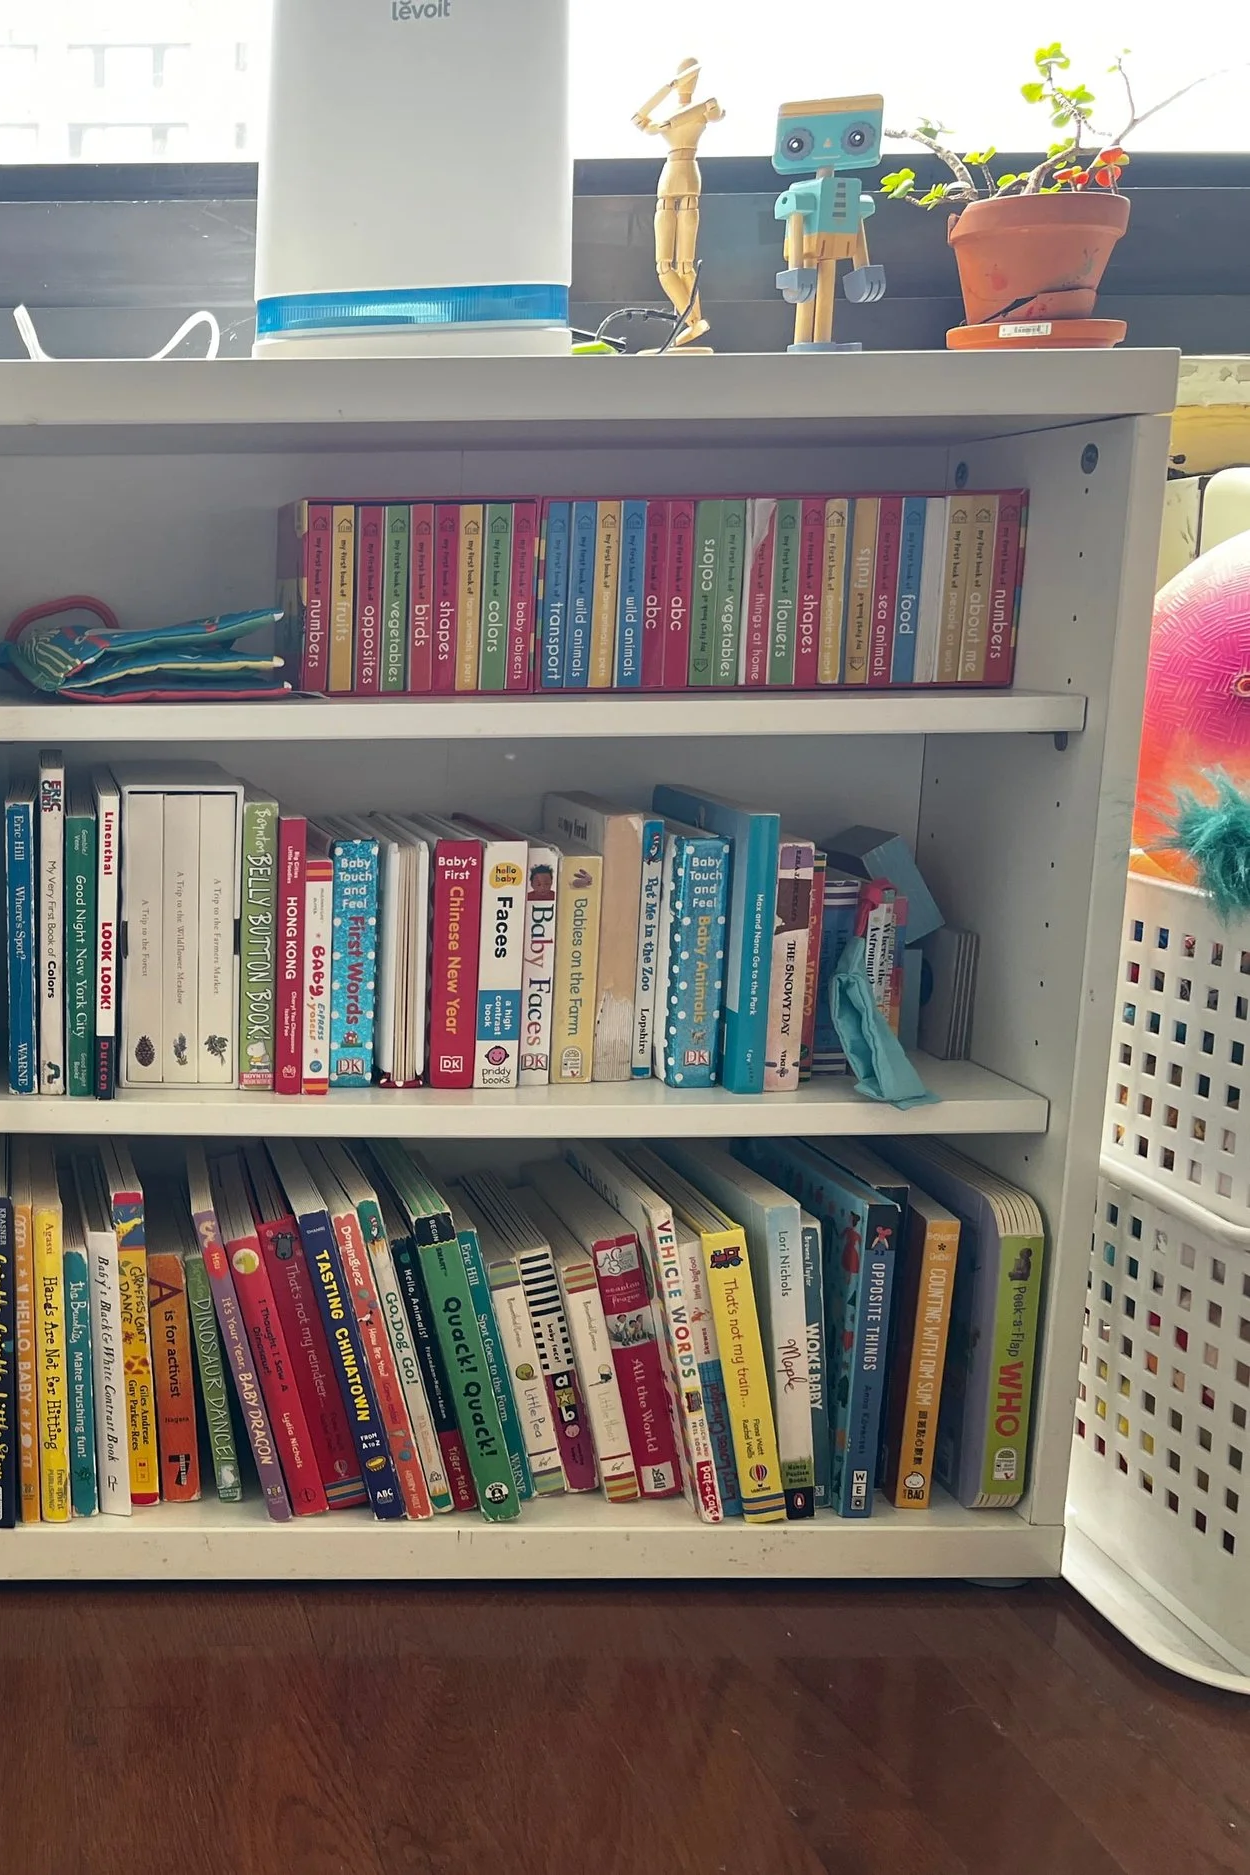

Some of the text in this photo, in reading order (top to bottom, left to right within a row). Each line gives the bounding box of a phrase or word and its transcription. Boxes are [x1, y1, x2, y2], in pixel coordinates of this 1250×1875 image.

[698, 538, 715, 591] colors
[309, 599, 325, 668] numbers
[388, 601, 402, 682] vegetables
[414, 604, 430, 647] birds
[436, 601, 455, 661] shapes
[486, 600, 503, 653] colors
[546, 601, 564, 681] transport
[645, 594, 661, 630] abc
[670, 596, 686, 631] abc
[719, 595, 734, 677] vegetables
[774, 598, 793, 658] flowers
[800, 594, 819, 654] shapes
[899, 593, 915, 635] food
[989, 589, 1007, 659] numbers
[362, 605, 376, 684] opposites
[13, 815, 25, 860] Eric Hill
[104, 811, 114, 875] Linenthal
[341, 857, 371, 871] Baby
[438, 856, 477, 869] Baby's
[692, 856, 722, 869] Baby
[175, 880, 184, 897] Trip
[176, 899, 183, 908] to
[338, 871, 372, 882] Touch
[343, 885, 367, 896] and
[444, 870, 470, 880] First
[689, 870, 723, 881] Touch
[692, 897, 717, 908] Feel
[694, 884, 717, 894] and
[13, 886, 26, 960] Where's Spot?
[46, 860, 57, 999] My Very First Book of Colors
[176, 910, 184, 922] the
[244, 852, 273, 1040] BELLY BUTTON BOOK!
[285, 896, 298, 980] HONG KONG
[495, 896, 513, 959] Faces
[72, 875, 87, 1038] Good Night New York City
[100, 921, 112, 1010] LOOK LOOK!
[176, 925, 185, 970] Wildflower
[346, 915, 365, 1025] First Words
[445, 885, 464, 1035] Chinese New Year
[524, 904, 554, 1047] Baby Faces
[567, 897, 588, 1037] Babies on the Farm
[693, 915, 711, 1024] Baby Animals
[749, 894, 764, 1016] Max and Nana Go to the Park
[176, 971, 184, 1005] Meadow
[484, 1003, 492, 1028] book
[493, 995, 501, 1036] contrast
[780, 940, 797, 1036] THE SNOWY DAY
[637, 1008, 650, 1055] Lopshire
[17, 1042, 28, 1087] WARNE
[99, 1041, 109, 1090] Dutton
[483, 1076, 510, 1085] books
[779, 1049, 788, 1078] VIKING
[0, 1207, 8, 1246] KRASNER
[43, 1222, 55, 1255] Agassi
[341, 1225, 364, 1287] Dominguez
[210, 1252, 221, 1270] Hsu
[460, 1243, 480, 1286] Eric Hill
[778, 1230, 792, 1297] Lori Nichols
[403, 1269, 429, 1339] Hello, Animals!
[656, 1219, 697, 1379] VEHICLE WORDS
[862, 1262, 887, 1371] OPPOSITE THINGS
[43, 1276, 62, 1450] Hands Are Not for Hitting
[149, 1277, 184, 1399] A is for activist
[192, 1296, 223, 1391] DINOSAUR
[315, 1249, 345, 1320] TASTING
[335, 1327, 371, 1421] CHINATOWN
[546, 1323, 562, 1364] baby face!
[723, 1278, 750, 1408] That's not my train...
[995, 1286, 1027, 1438] Peek-a-Flap WHO
[441, 1296, 498, 1457] Quack! Quack!
[777, 1338, 807, 1395] Maple
[73, 1351, 87, 1458] Make brushing fun!
[139, 1384, 151, 1445] Giles Andreae
[203, 1394, 235, 1461] DANCE!
[630, 1358, 660, 1453] All the World
[360, 1432, 377, 1441] FROM
[741, 1418, 755, 1459] Rachel Wells
[753, 1418, 765, 1456] Fiona Watt
[509, 1452, 527, 1494] WARNE
